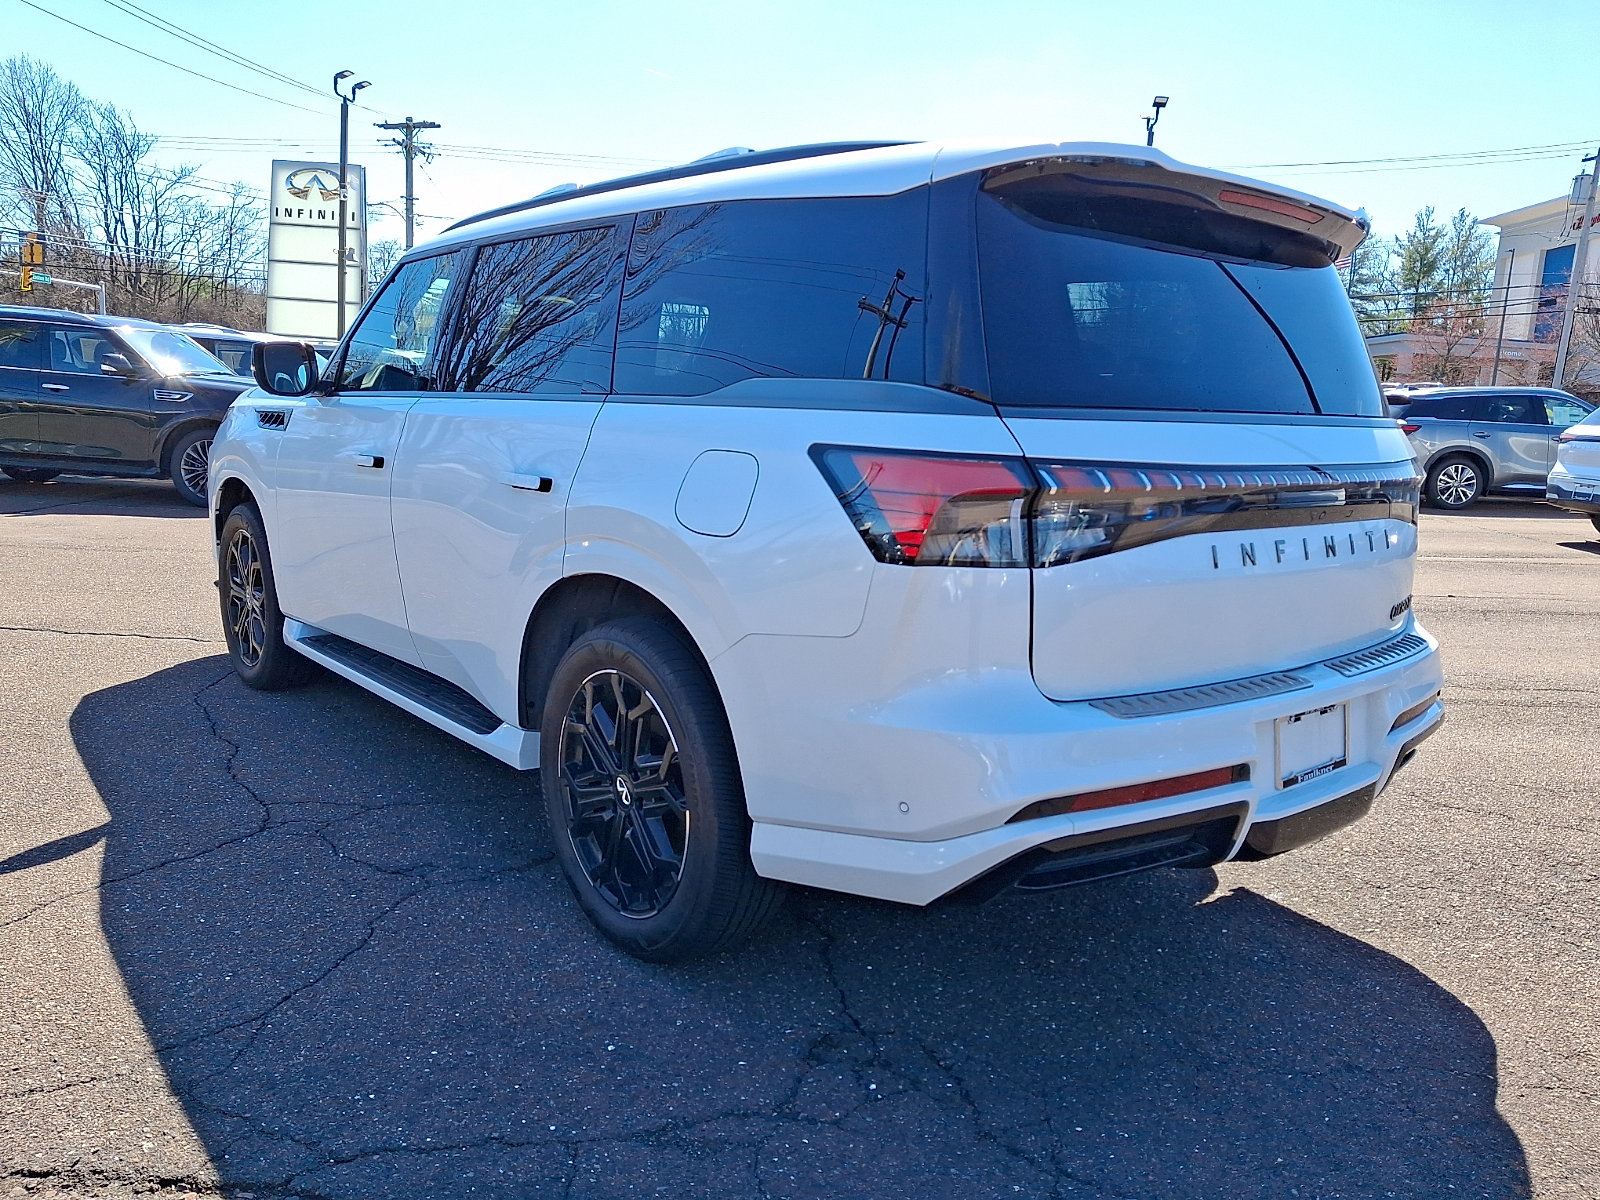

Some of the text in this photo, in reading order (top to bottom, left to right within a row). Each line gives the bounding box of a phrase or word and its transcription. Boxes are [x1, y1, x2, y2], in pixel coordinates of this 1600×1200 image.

[275, 206, 356, 222] INFINII
[1211, 529, 1390, 569] INFINITI
[1297, 764, 1335, 783] Faulkner
